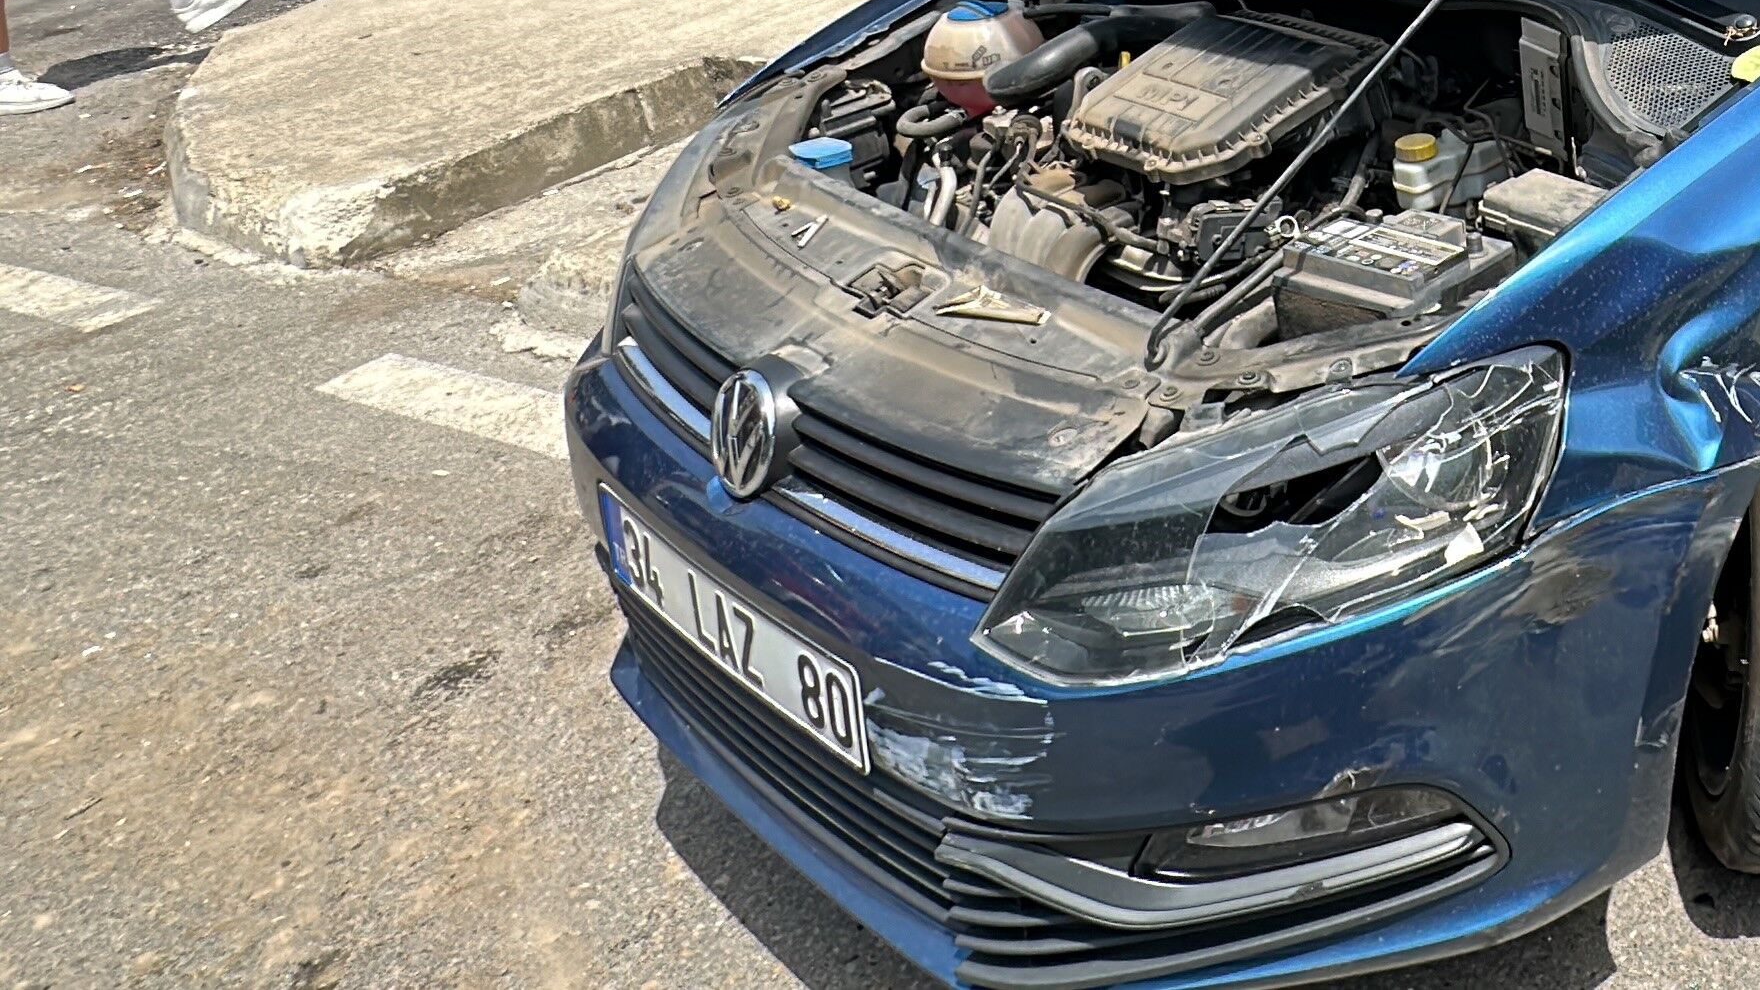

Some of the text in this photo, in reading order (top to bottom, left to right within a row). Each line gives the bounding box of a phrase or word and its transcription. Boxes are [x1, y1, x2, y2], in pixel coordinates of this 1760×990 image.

[623, 516, 853, 749] 34 LAZ 80
